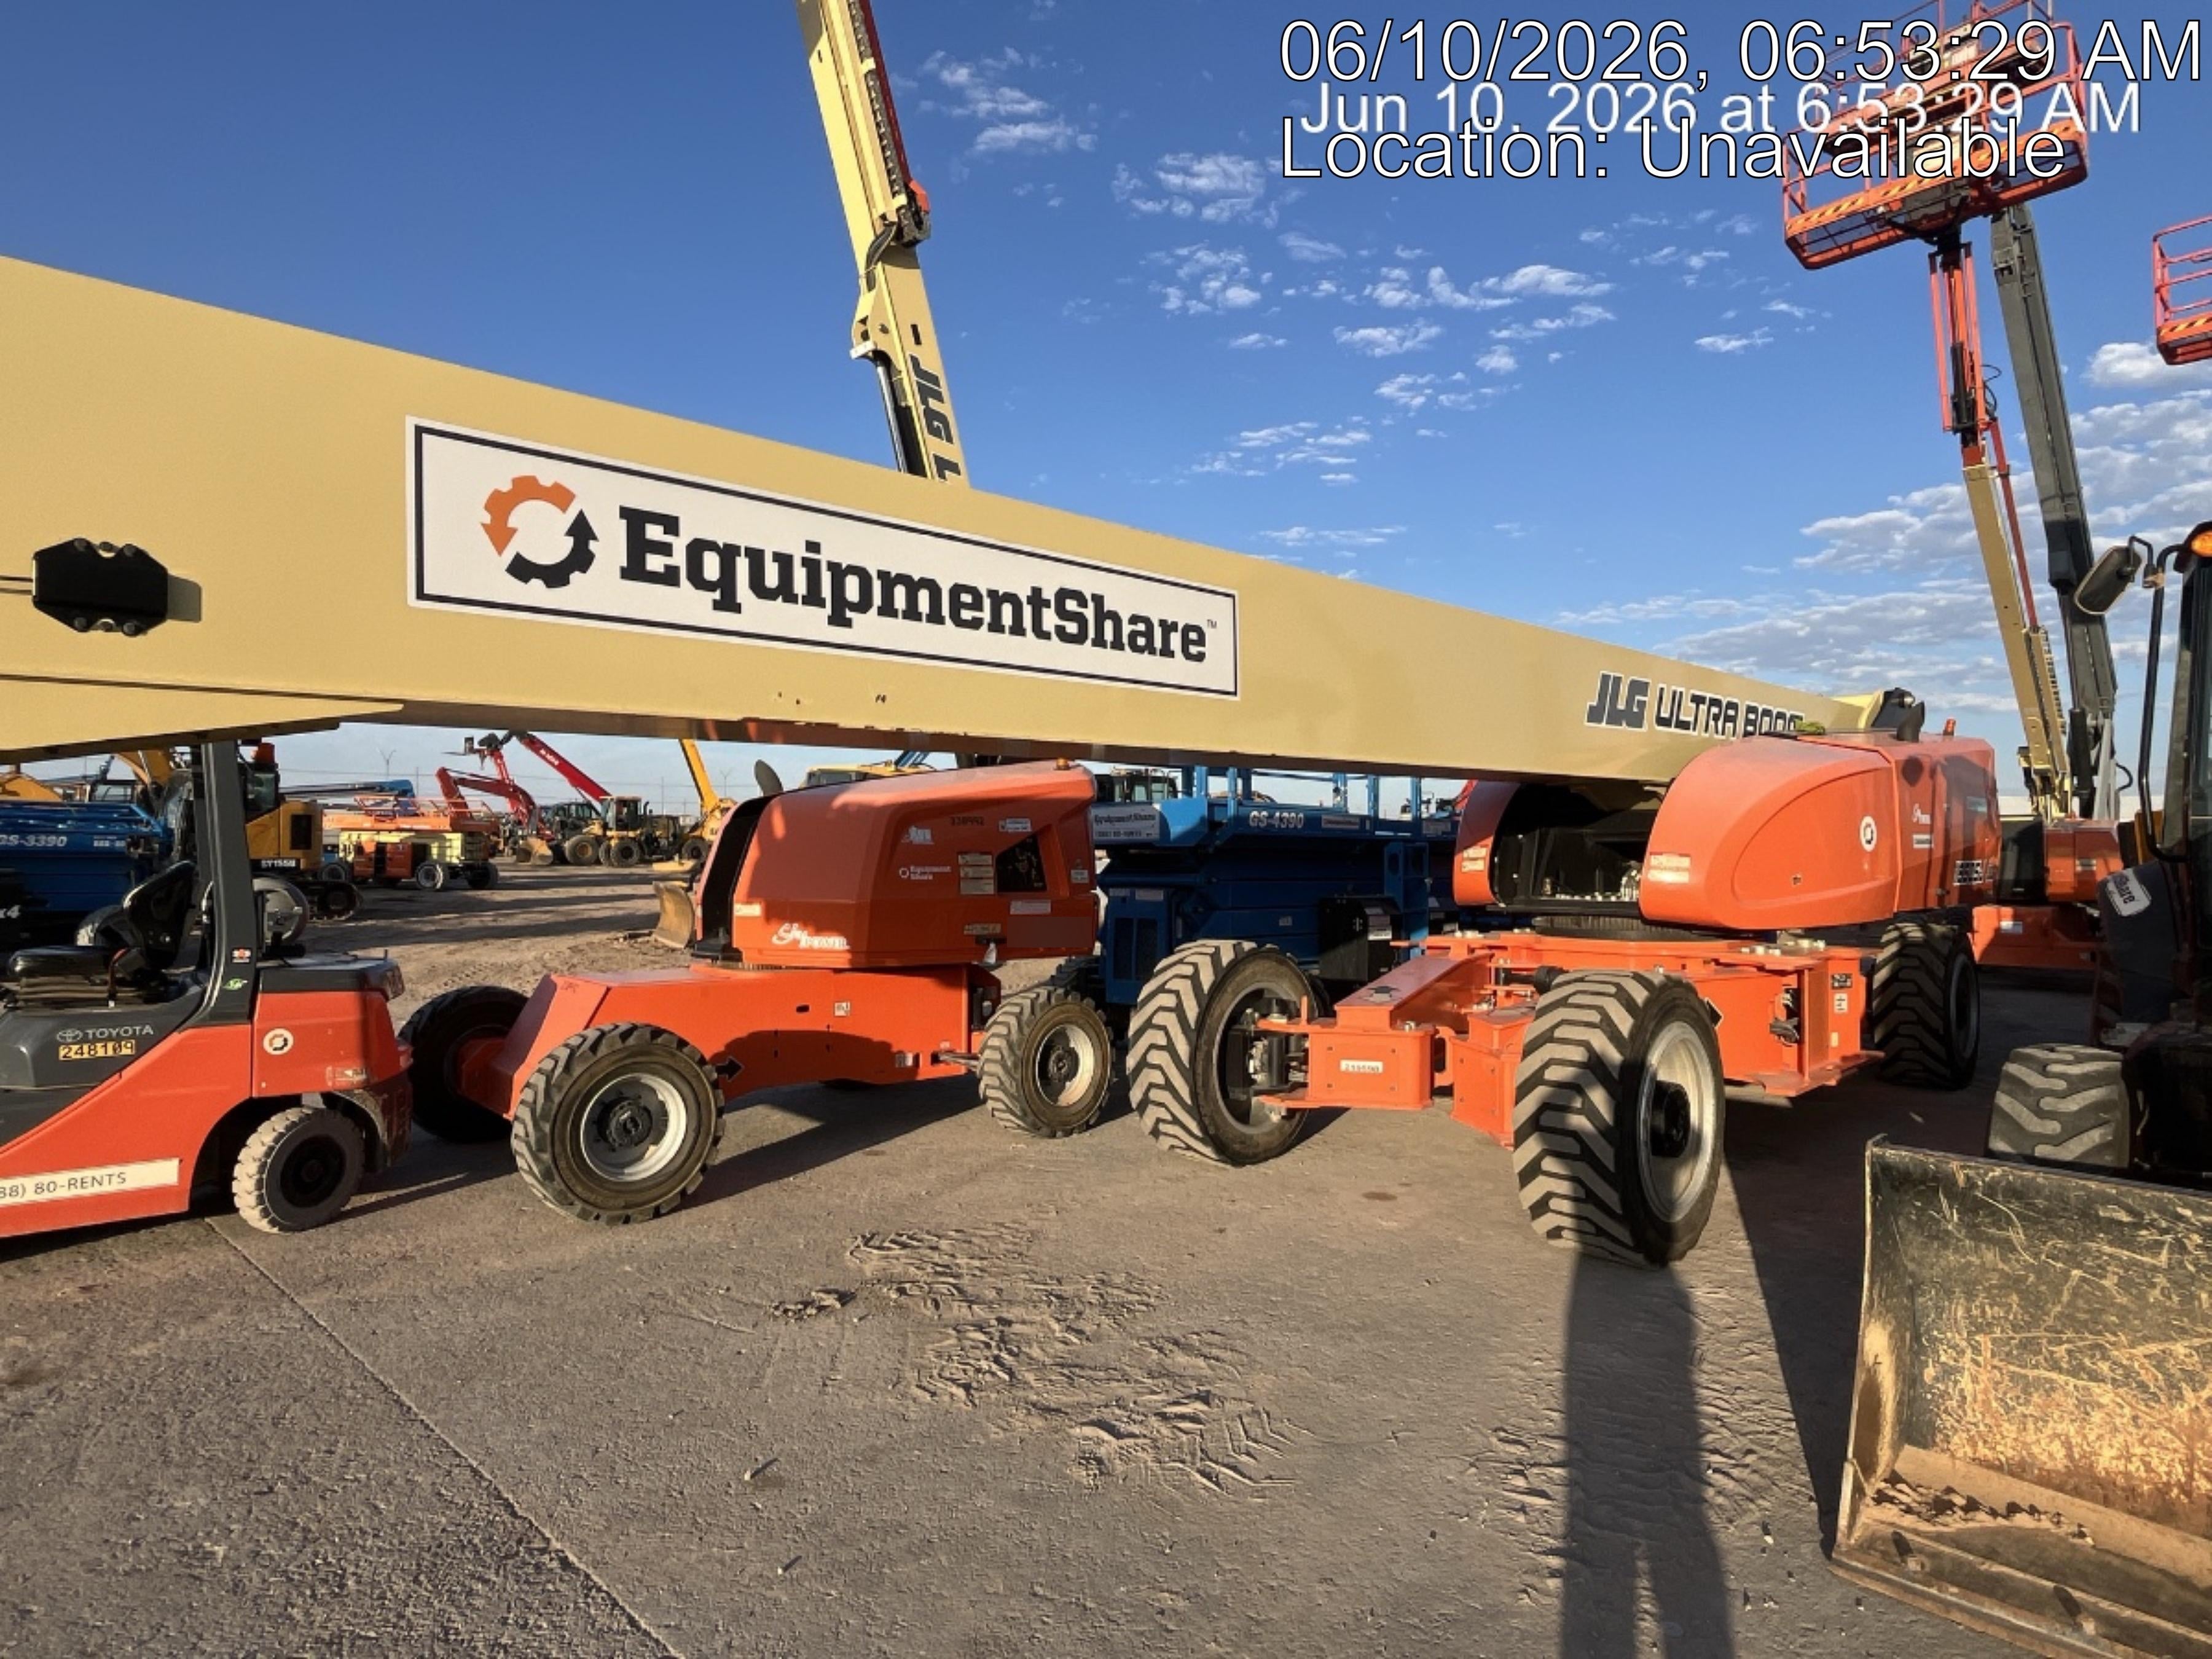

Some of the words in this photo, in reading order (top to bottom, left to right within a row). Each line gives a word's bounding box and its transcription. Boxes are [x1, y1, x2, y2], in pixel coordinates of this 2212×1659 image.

[909, 354, 954, 445] JLG
[619, 506, 1207, 663] EquipmentShare
[1585, 671, 1651, 731] JLG
[1655, 683, 1739, 740] ULTRA
[1249, 810, 1304, 829] GS-4390
[85, 1024, 154, 1039] TOYOTA
[34, 1171, 127, 1194] 80-RENTS
